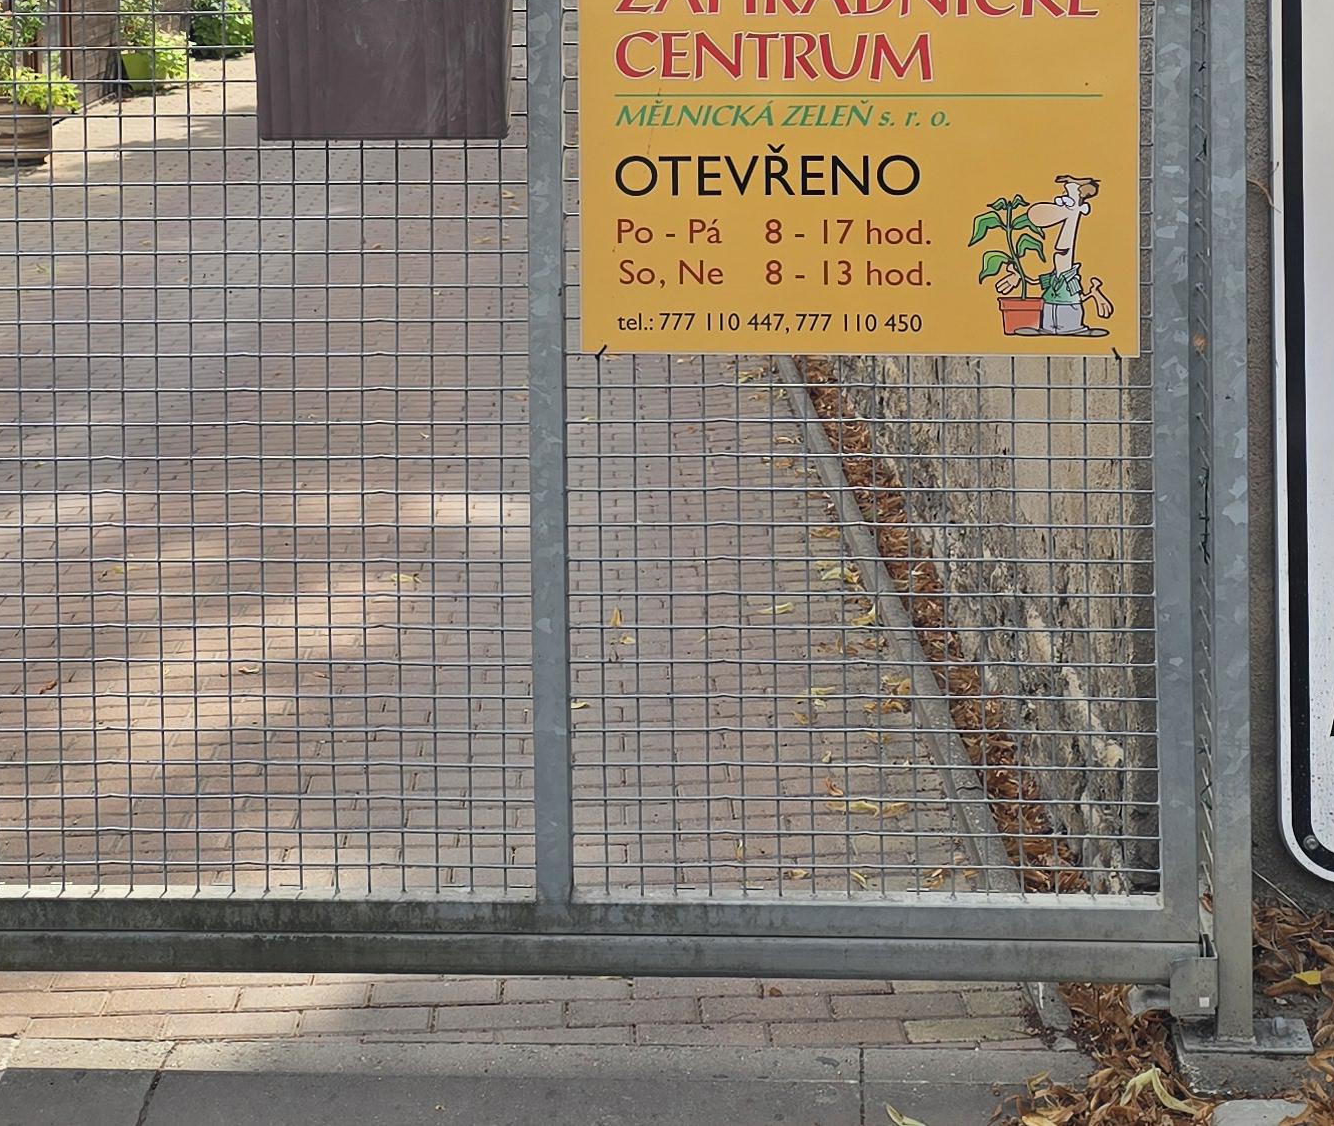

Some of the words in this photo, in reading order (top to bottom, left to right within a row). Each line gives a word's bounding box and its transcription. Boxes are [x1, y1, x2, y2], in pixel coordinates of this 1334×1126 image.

[615, 32, 933, 81] CENTRUM
[614, 100, 775, 129] MĚLNICKÁ
[780, 100, 873, 128] ZELEŇ
[615, 143, 920, 197] OTEVŘENO
[617, 218, 654, 244] Po
[688, 218, 723, 245] Pá
[764, 218, 783, 245] 8
[823, 218, 855, 245] 17
[866, 219, 932, 246] hod.
[619, 259, 666, 289] So,
[678, 259, 724, 286] Ne
[765, 259, 783, 286] 8
[823, 259, 852, 286] 13
[866, 260, 932, 287] hod.
[617, 312, 654, 331] tel.:
[707, 312, 740, 332] 110
[843, 313, 877, 333] 110
[883, 313, 923, 333] 450
